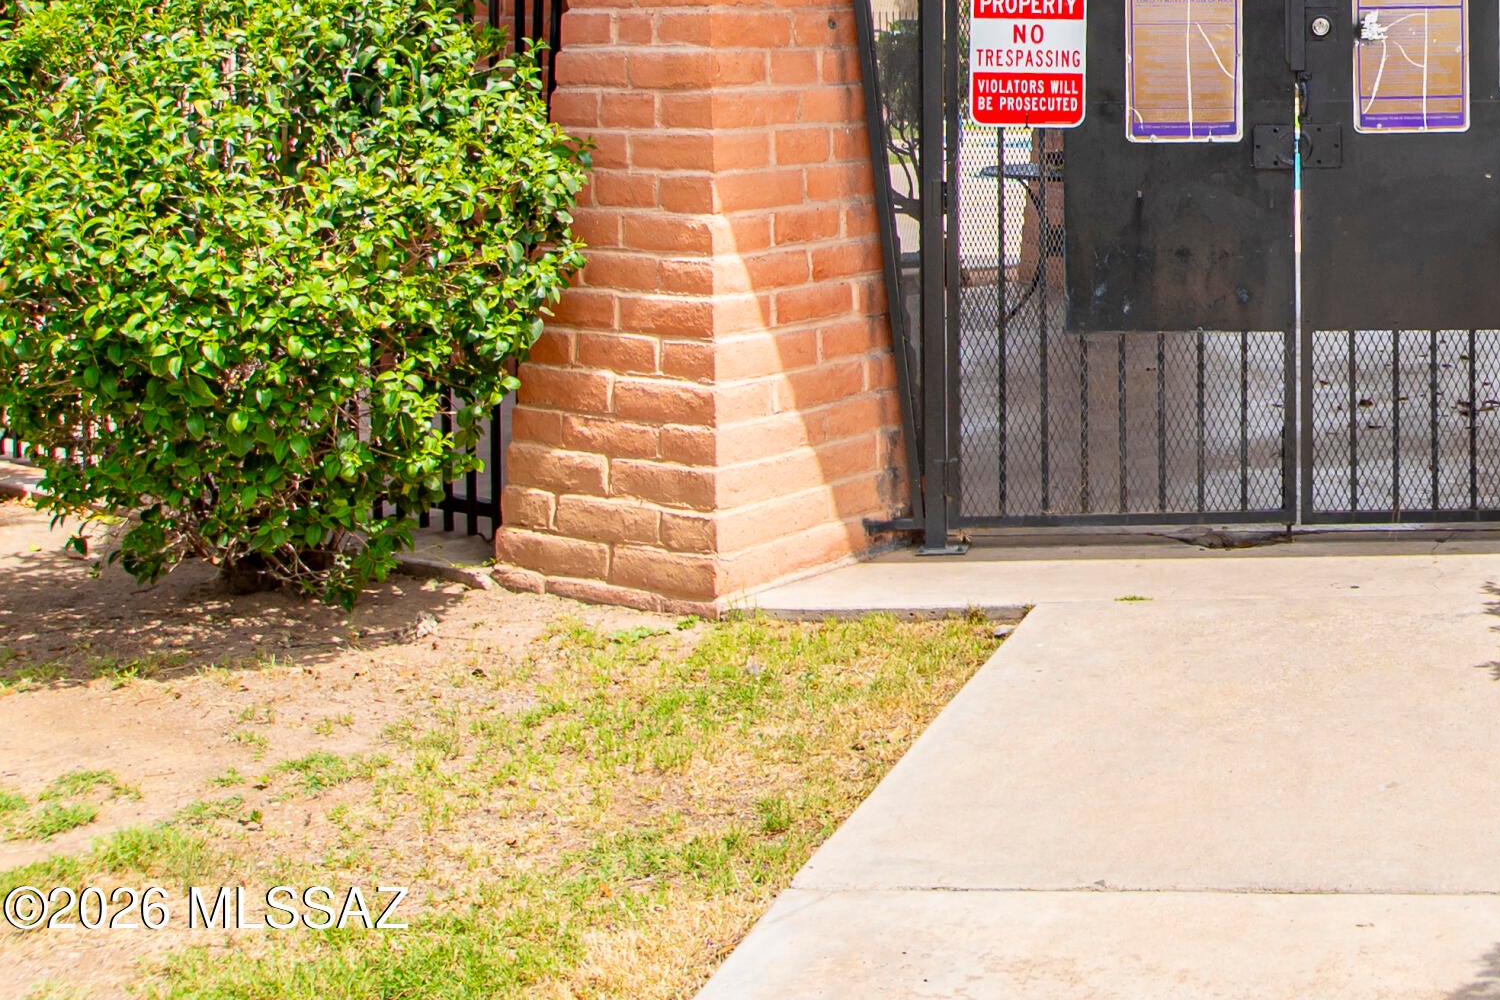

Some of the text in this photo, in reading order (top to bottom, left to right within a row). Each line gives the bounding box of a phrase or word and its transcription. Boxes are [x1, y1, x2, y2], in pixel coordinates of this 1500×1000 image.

[1013, 24, 1044, 44] NO
[976, 49, 1081, 68] TRESPASSING
[977, 79, 1079, 94] VIOLATORS WILL
[977, 96, 1078, 111] BE PROSECUTED
